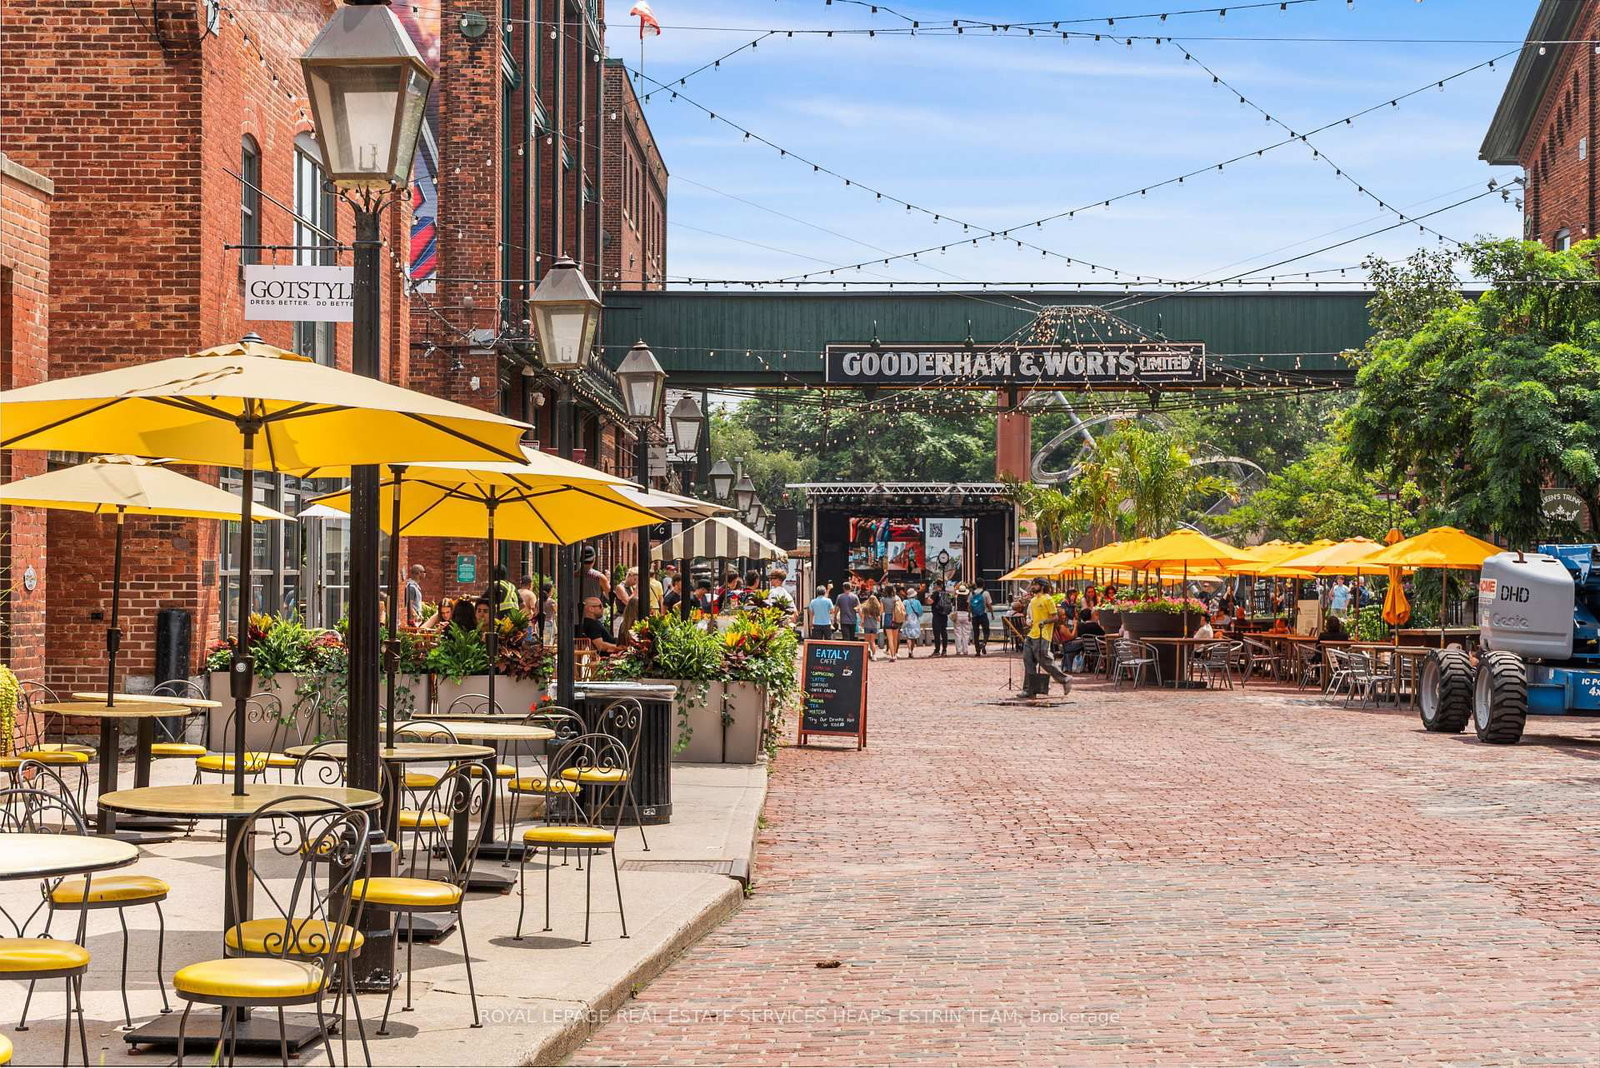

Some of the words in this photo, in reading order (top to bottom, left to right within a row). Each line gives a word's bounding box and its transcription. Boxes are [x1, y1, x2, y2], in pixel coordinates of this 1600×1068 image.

[250, 280, 354, 300] GOTSTYL
[842, 351, 1012, 376] GOODERHAM
[1018, 351, 1043, 376] &
[1043, 351, 1135, 376] WORTS
[1137, 356, 1192, 371] LIMITED
[1562, 493, 1582, 506] TRUNK
[1480, 580, 1496, 593] CME
[1500, 585, 1530, 603] DHD
[815, 648, 850, 660] EATALY
